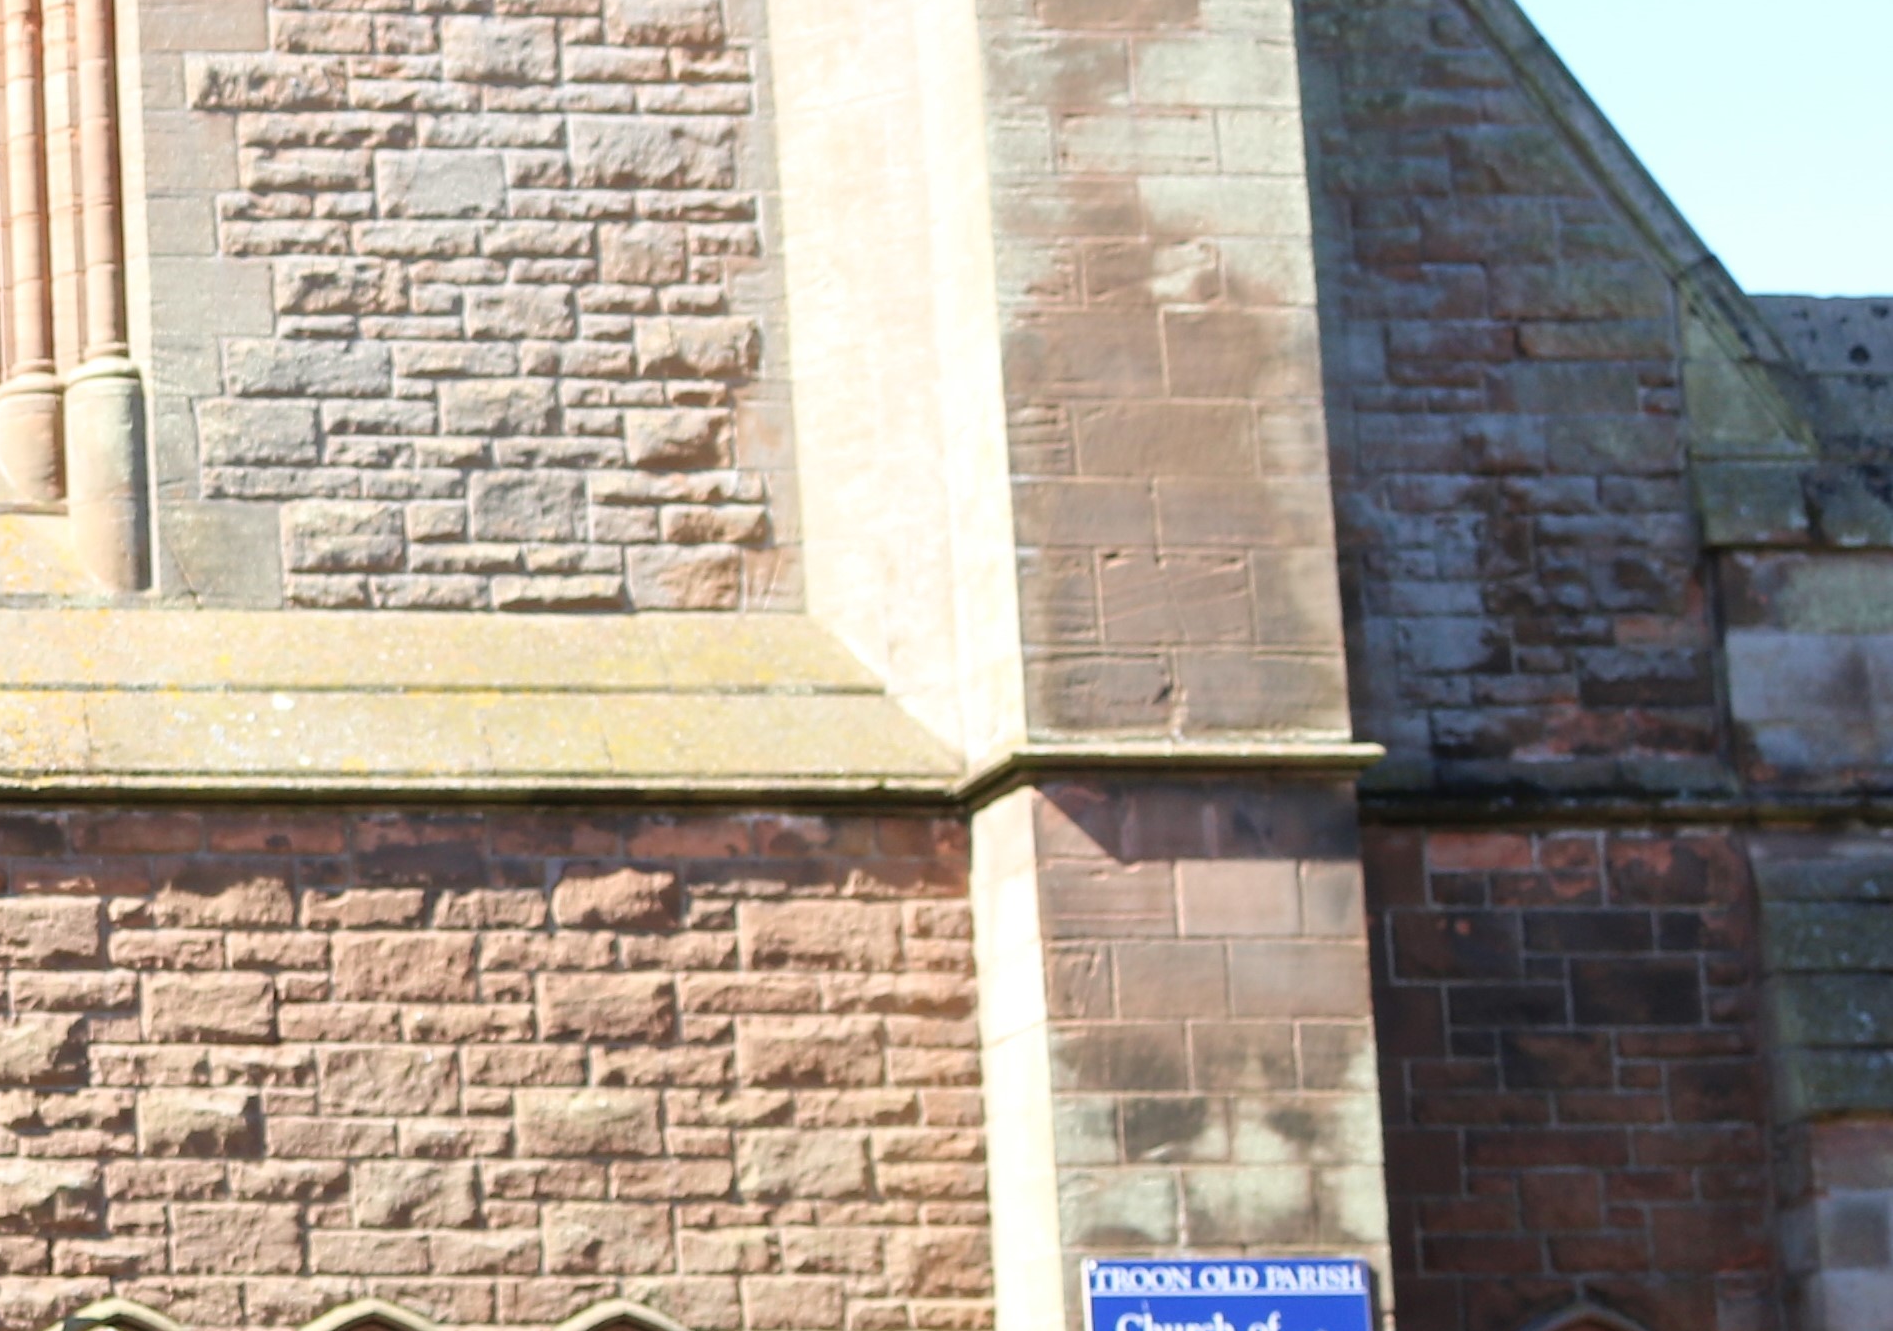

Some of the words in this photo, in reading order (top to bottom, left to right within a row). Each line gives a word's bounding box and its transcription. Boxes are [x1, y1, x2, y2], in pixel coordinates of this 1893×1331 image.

[1093, 1265, 1192, 1291] TROON
[1198, 1265, 1260, 1291] OLD
[1264, 1264, 1364, 1291] PARISH
